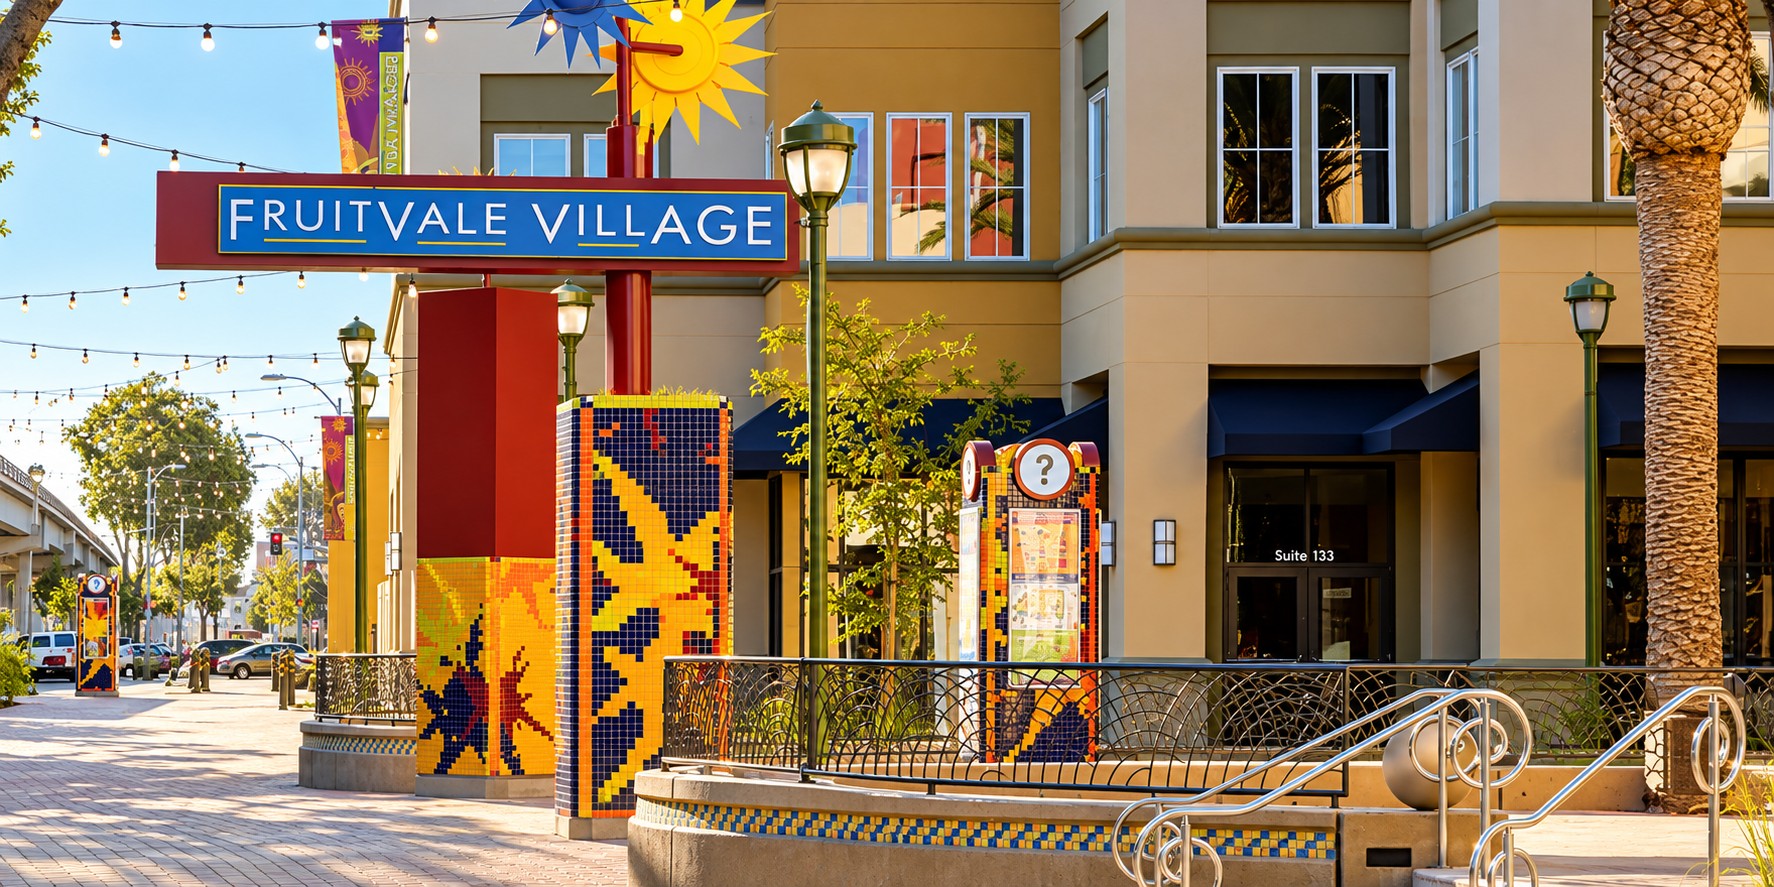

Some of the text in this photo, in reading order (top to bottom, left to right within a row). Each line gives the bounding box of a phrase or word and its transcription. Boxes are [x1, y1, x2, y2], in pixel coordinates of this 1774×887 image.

[230, 198, 772, 246] FRUITVALE VILLAGE
[1035, 453, 1054, 486] ?
[1275, 549, 1335, 562] Suite 133
